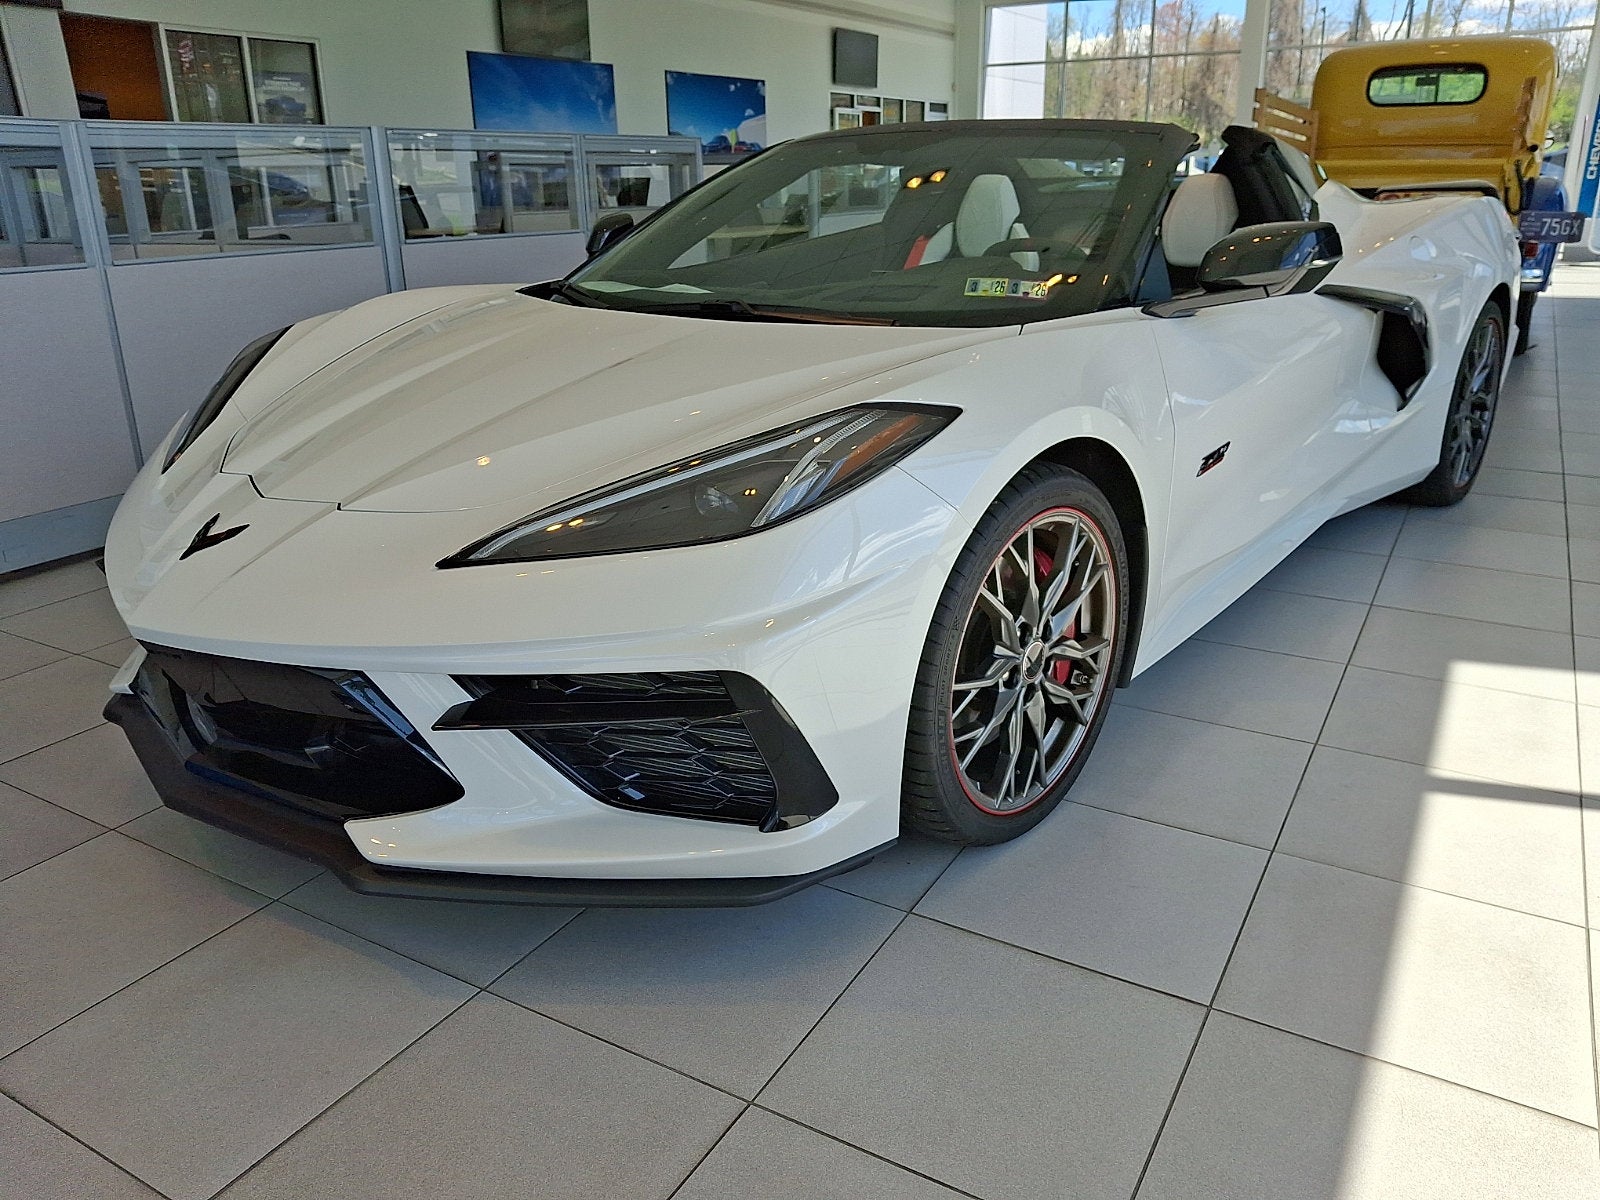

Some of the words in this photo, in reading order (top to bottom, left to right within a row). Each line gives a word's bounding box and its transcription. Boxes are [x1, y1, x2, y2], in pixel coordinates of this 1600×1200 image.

[1540, 218, 1581, 236] 75GX
[970, 282, 978, 293] 3
[994, 280, 1006, 294] 26
[1011, 282, 1019, 294] 3
[1035, 283, 1047, 297] 26
